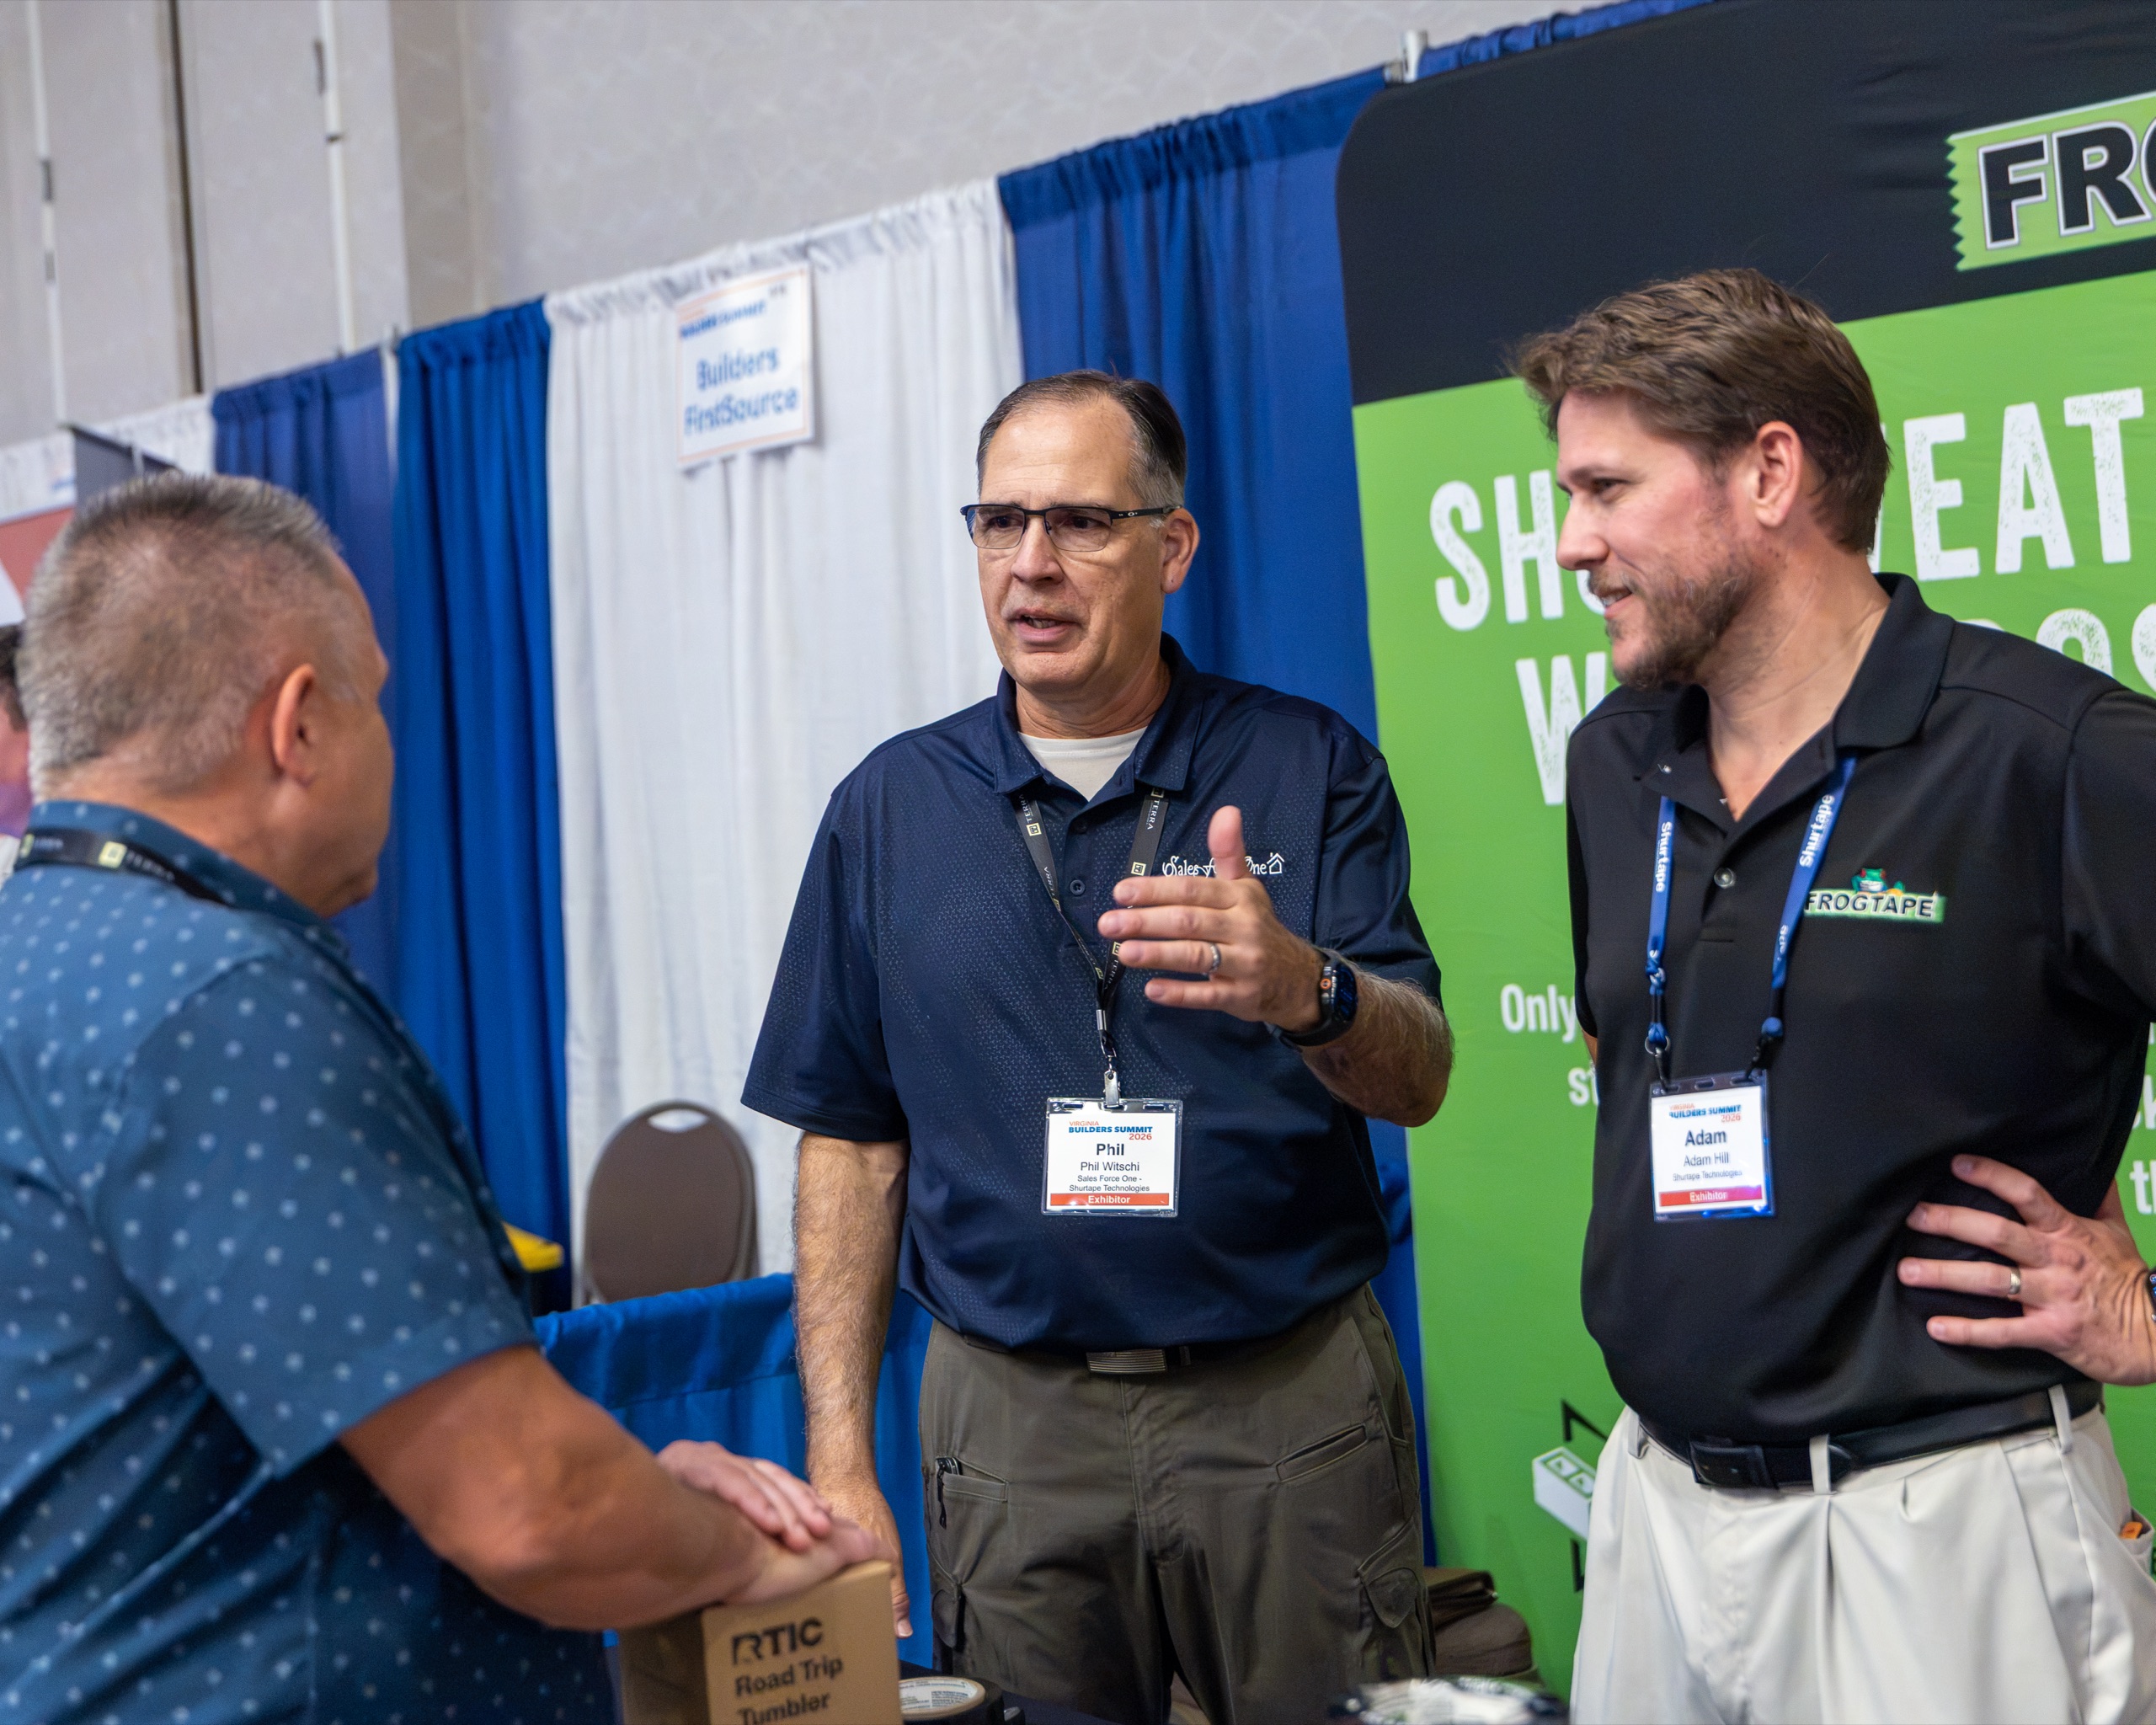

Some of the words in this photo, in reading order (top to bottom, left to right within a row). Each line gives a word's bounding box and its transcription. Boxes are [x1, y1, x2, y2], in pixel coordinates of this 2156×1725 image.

[1978, 120, 2156, 250] FR
[1430, 469, 1605, 632] SH
[1868, 387, 2144, 581] EAT
[1147, 798, 1161, 830] TERRA
[1799, 794, 1835, 868] Shurtape
[1655, 821, 1673, 893] Shurtape
[1804, 891, 1935, 919] FROGTAPE
[1500, 983, 1577, 1044] Only
[1708, 1104, 1742, 1116] SUMMIT
[1721, 1113, 1742, 1123] 2026
[1684, 1129, 1727, 1146] Adam
[1096, 1143, 1125, 1156] Phil
[1684, 1153, 1711, 1167] Adam
[1714, 1151, 1730, 1165] Hill
[1080, 1162, 1100, 1172] Phil
[1102, 1162, 1140, 1172] Witschi
[1672, 1172, 1700, 1182] Shurtape
[1701, 1169, 1742, 1179] Technologies
[1069, 1184, 1102, 1194] Shurtape
[1103, 1184, 1150, 1194] Technologies
[1087, 1195, 1131, 1204] Exhibitor
[1689, 1190, 1728, 1203] Exhibitor
[731, 1616, 825, 1666] RTIC
[735, 1663, 797, 1696] Road
[798, 1653, 844, 1680] Trip
[737, 1691, 831, 1725] Tumbler
